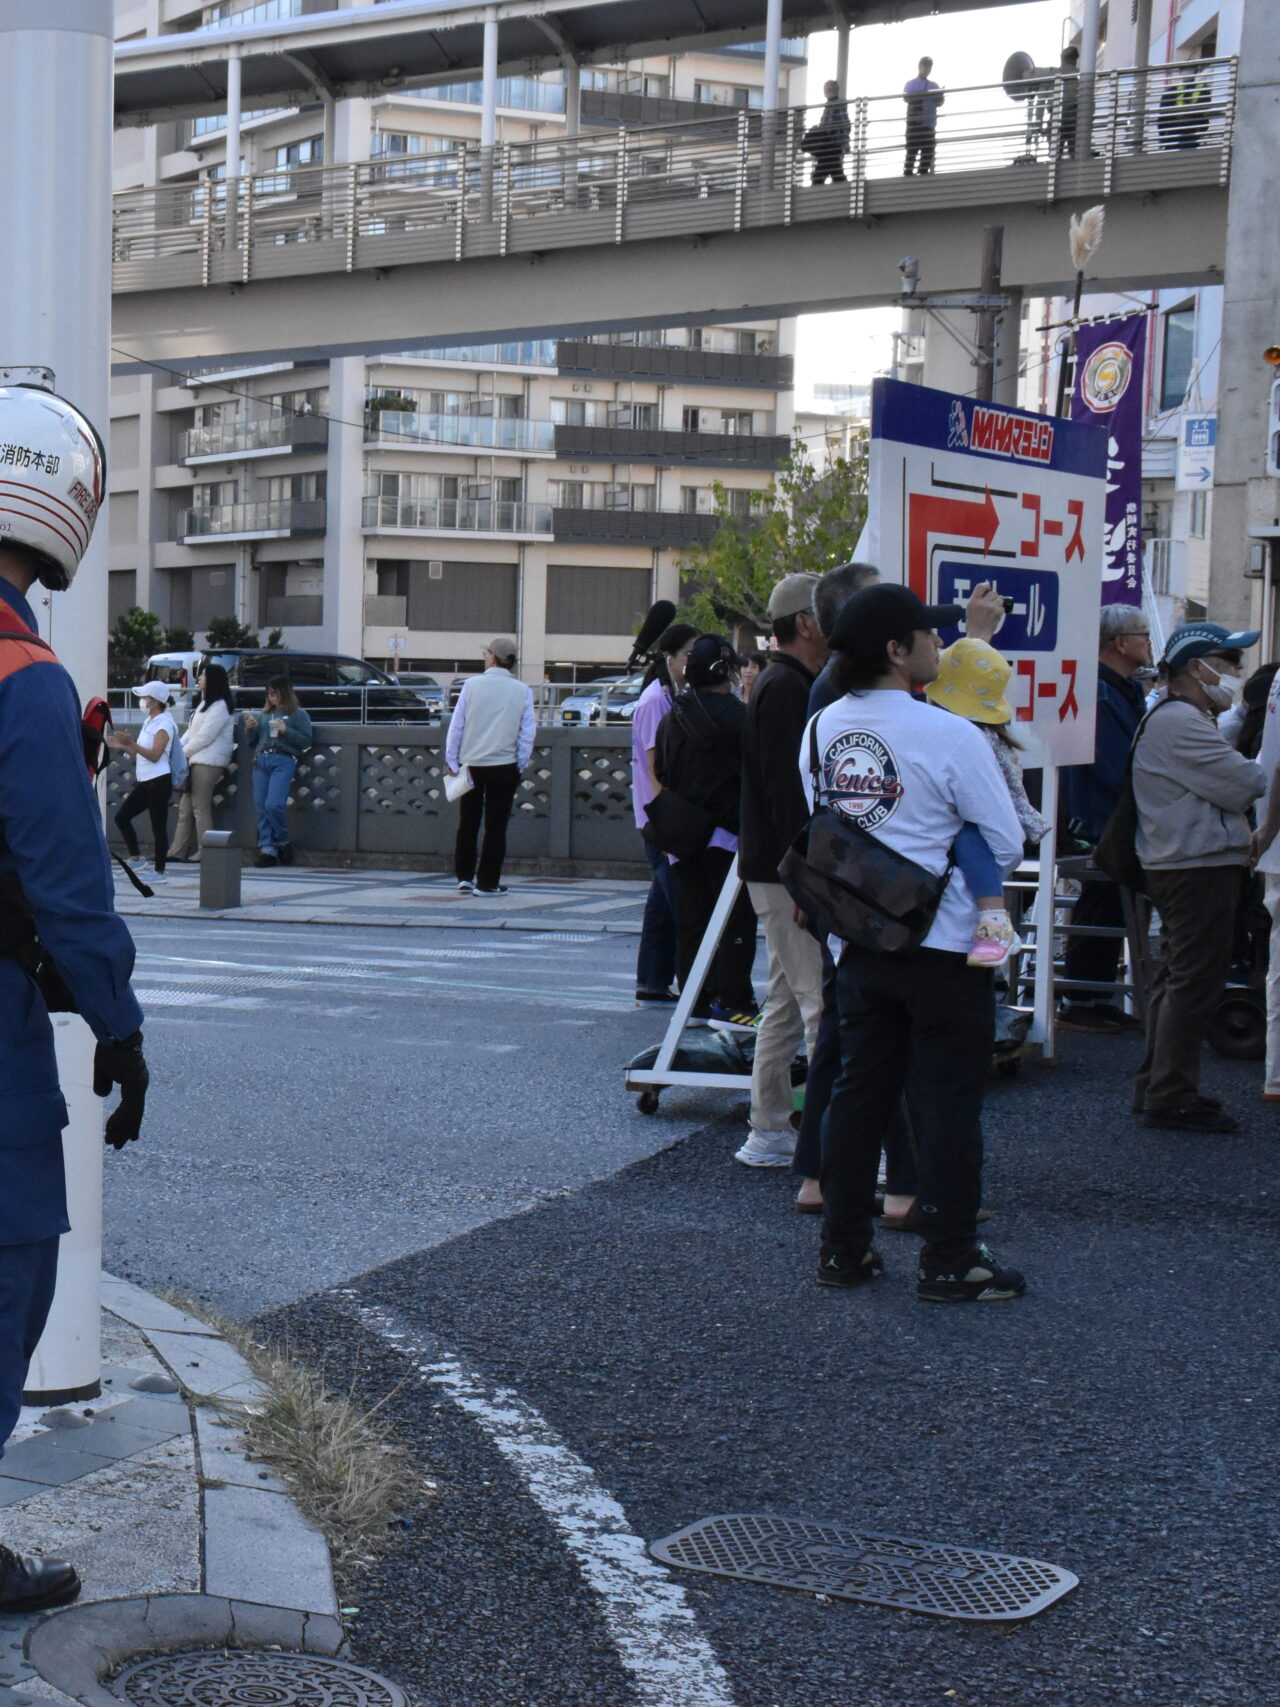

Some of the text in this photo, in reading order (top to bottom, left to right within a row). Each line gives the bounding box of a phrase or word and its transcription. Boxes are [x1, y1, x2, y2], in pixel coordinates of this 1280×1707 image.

[68, 480, 92, 509] FIRE
[1020, 493, 1086, 564] コース
[1016, 659, 1079, 724] コース
[829, 734, 889, 765] CALIFORNIA
[824, 757, 898, 794] Venice
[857, 805, 888, 828] CLUB
